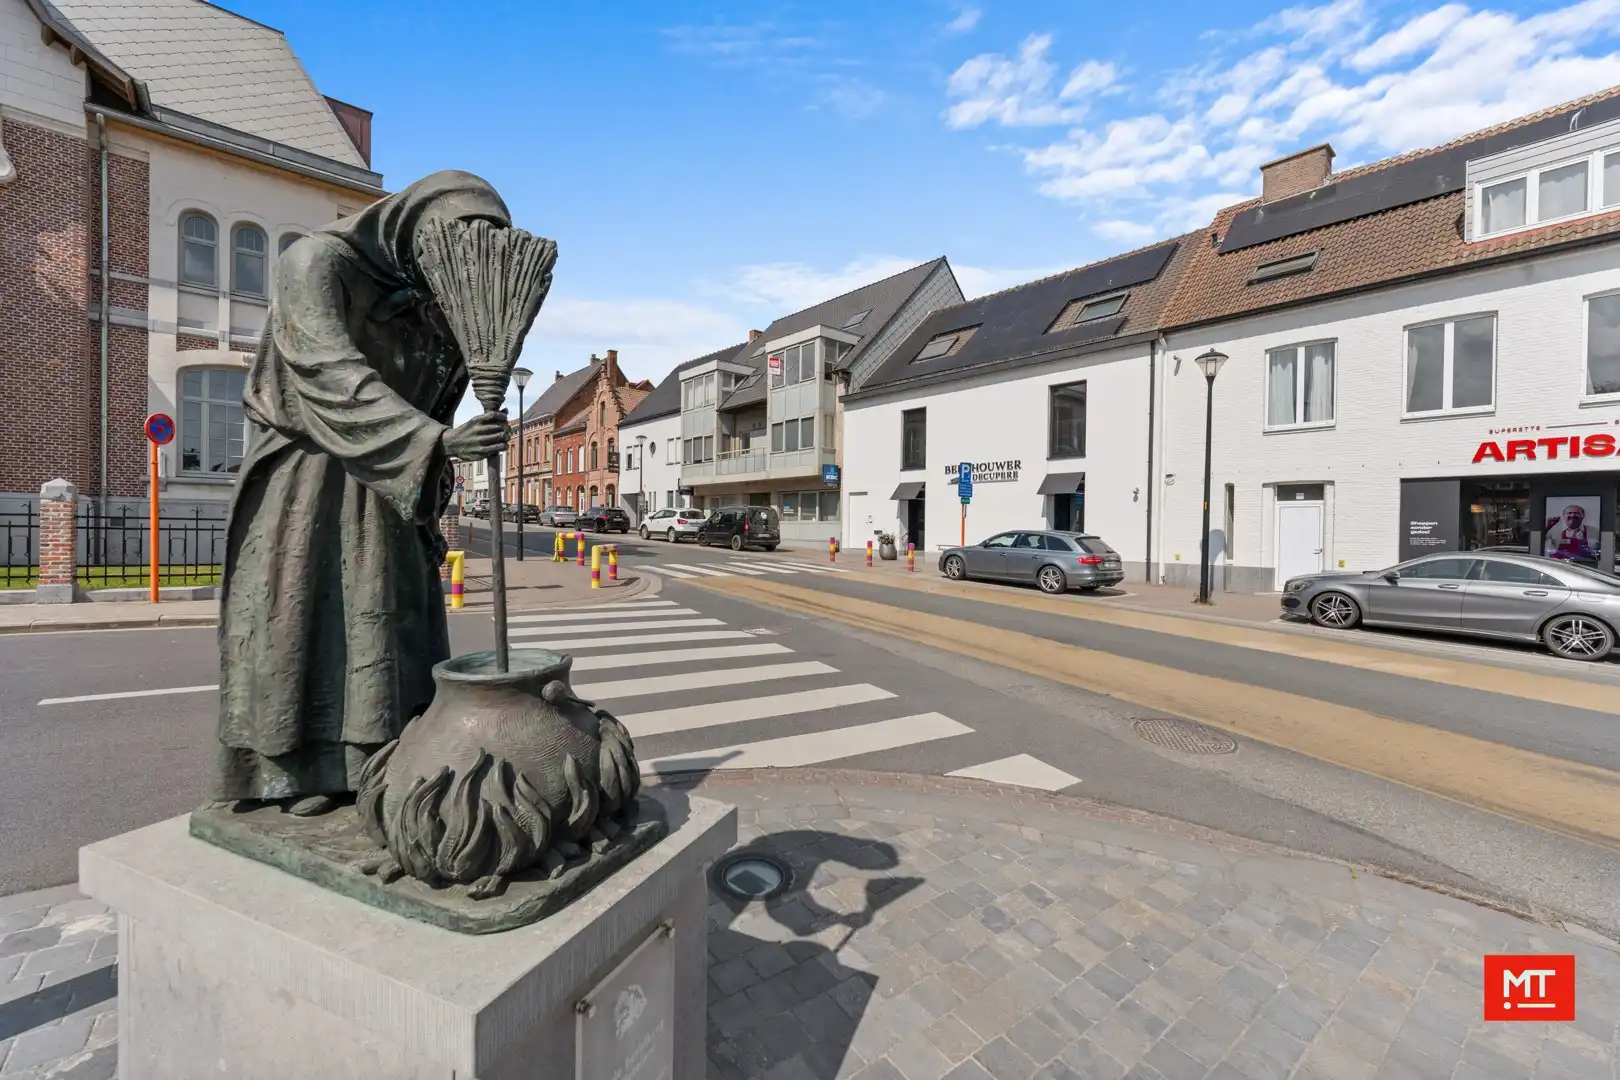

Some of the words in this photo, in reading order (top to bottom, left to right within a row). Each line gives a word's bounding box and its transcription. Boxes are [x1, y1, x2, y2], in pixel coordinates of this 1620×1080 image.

[1489, 425, 1541, 434] SUPERETTE
[1472, 434, 1620, 463] ARTIS
[945, 460, 1021, 474] BEHOUWER
[961, 463, 970, 479] P
[972, 471, 1018, 480] DECUPERE
